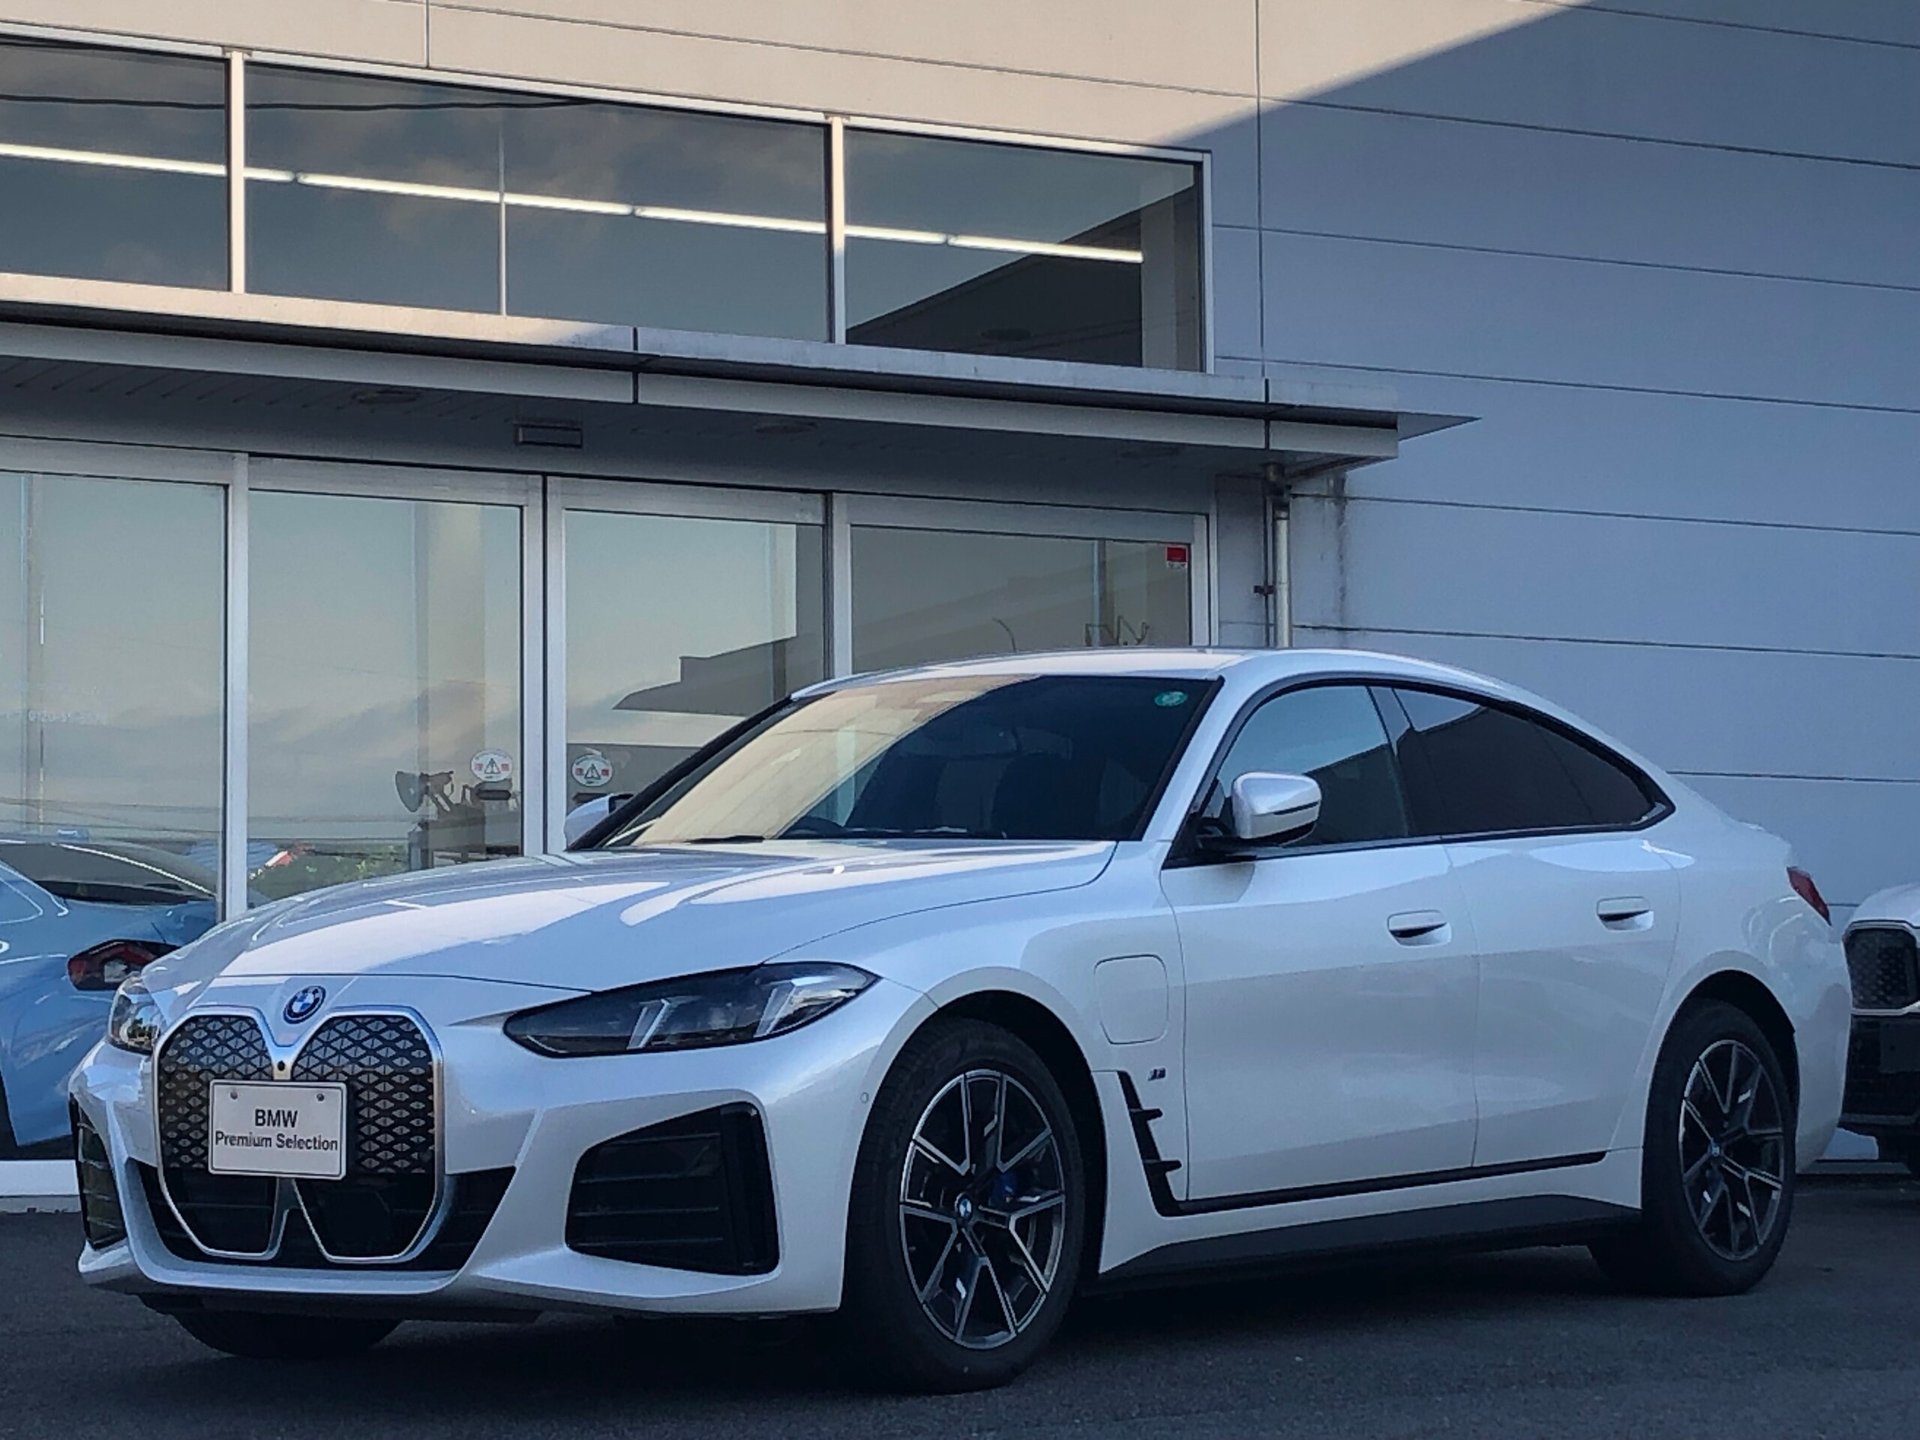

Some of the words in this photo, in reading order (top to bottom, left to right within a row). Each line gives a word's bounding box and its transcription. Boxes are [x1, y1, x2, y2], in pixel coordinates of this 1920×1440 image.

[254, 1108, 298, 1128] BMW
[215, 1131, 272, 1148] Premium
[275, 1133, 338, 1151] Selection
